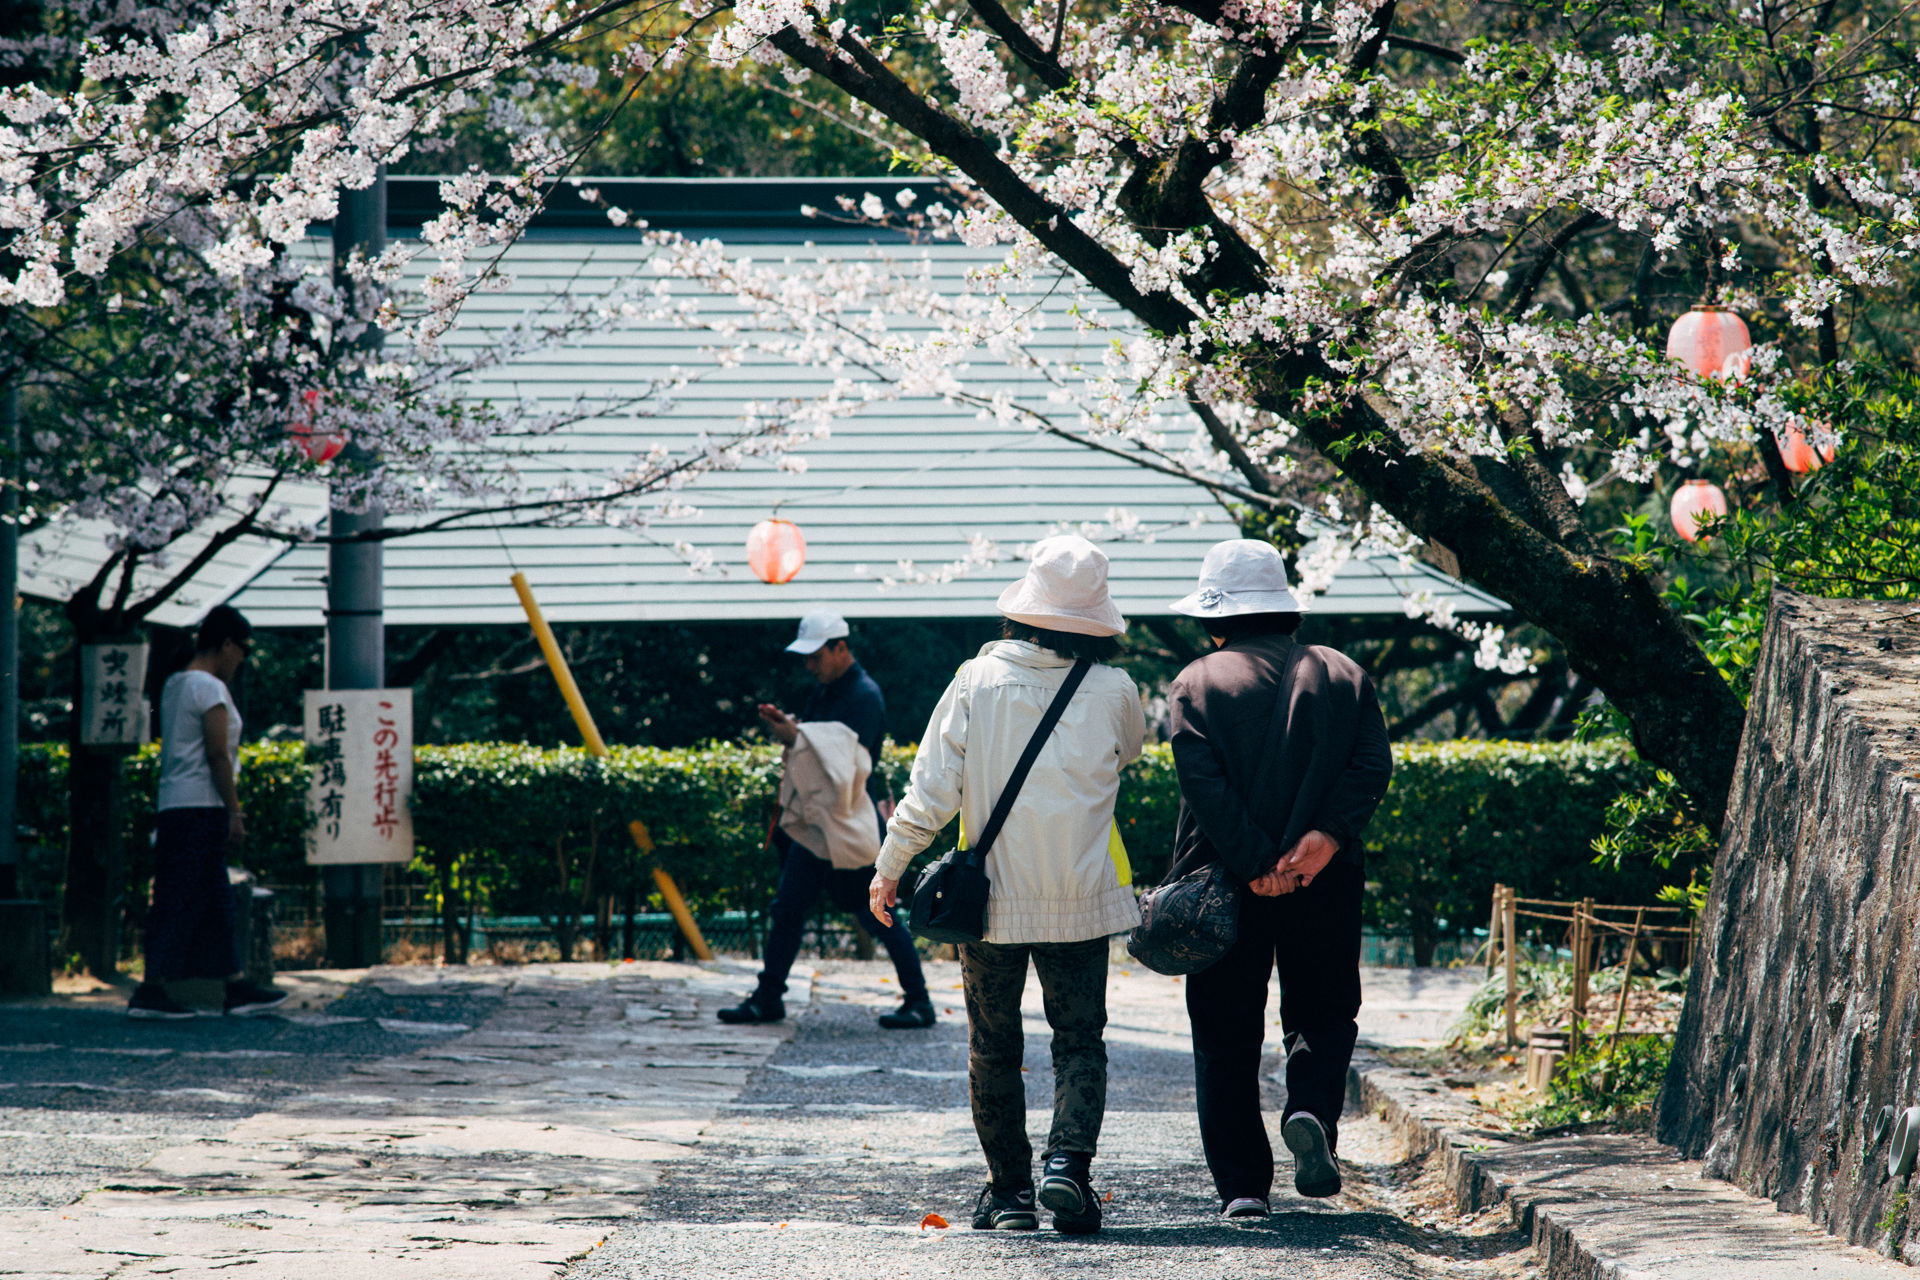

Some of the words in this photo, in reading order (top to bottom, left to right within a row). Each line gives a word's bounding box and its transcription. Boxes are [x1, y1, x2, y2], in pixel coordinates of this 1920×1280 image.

[318, 703, 347, 841] 駐車場有り
[372, 701, 399, 841] この先行止り
